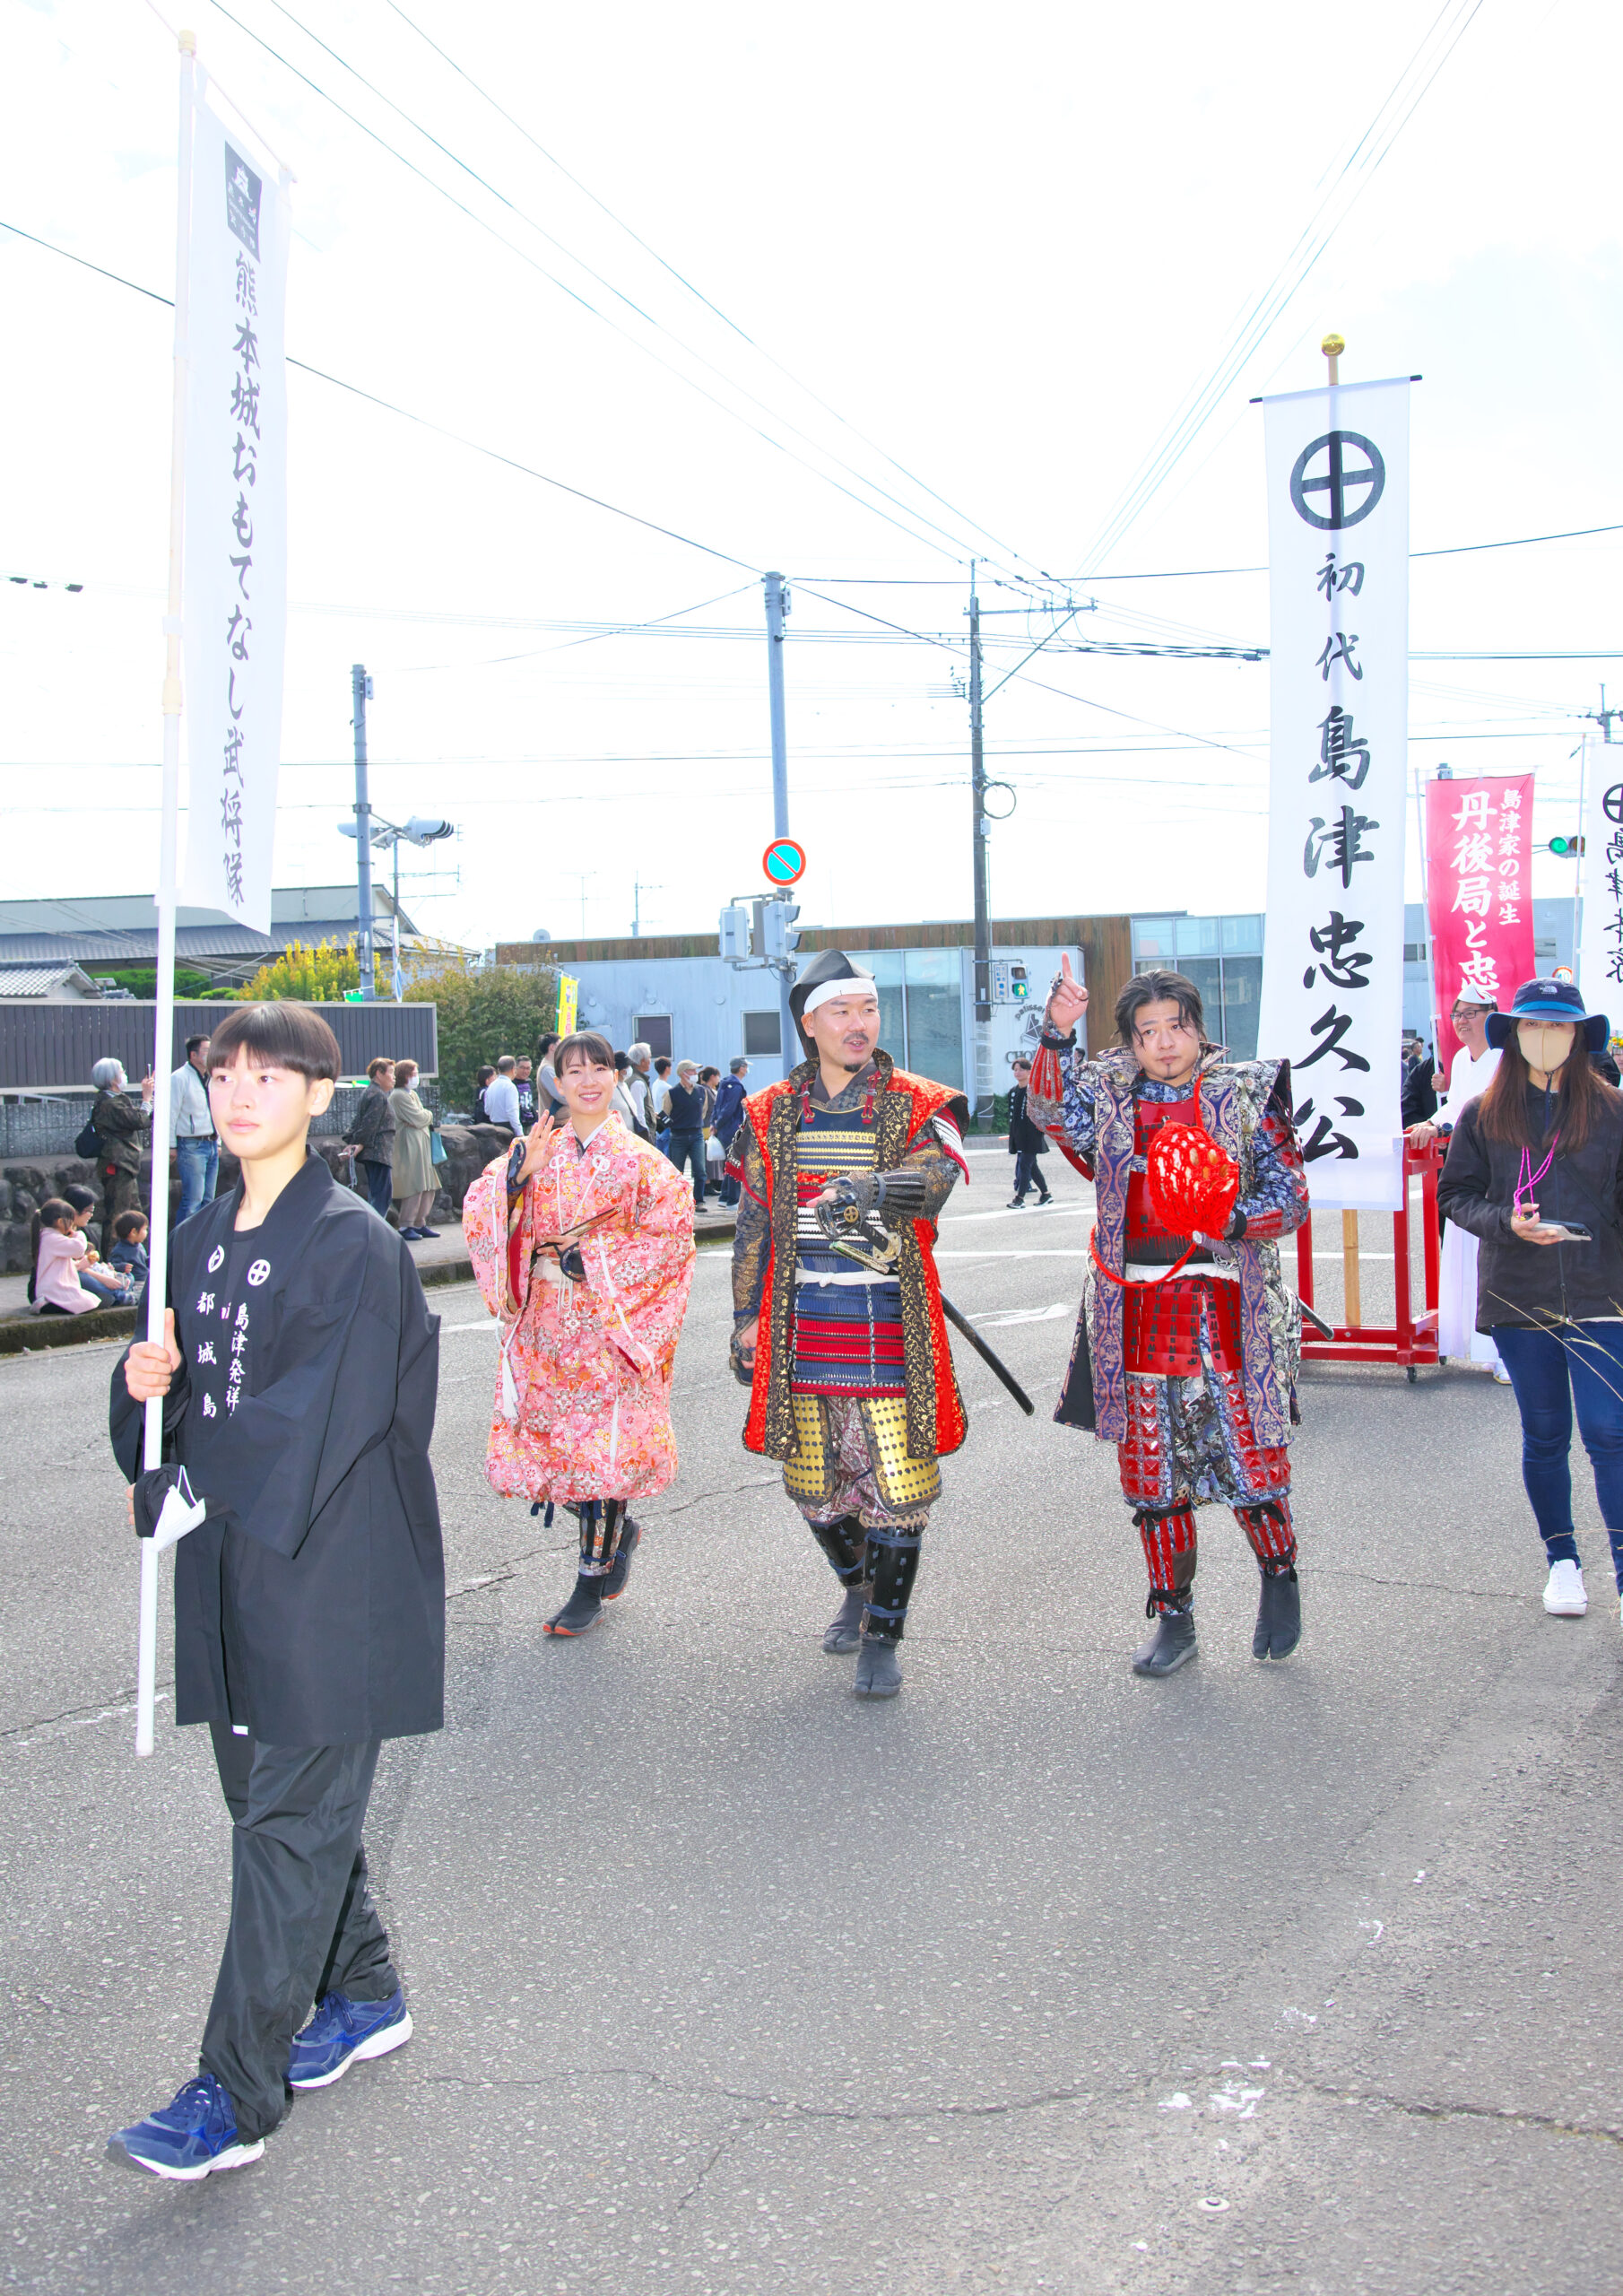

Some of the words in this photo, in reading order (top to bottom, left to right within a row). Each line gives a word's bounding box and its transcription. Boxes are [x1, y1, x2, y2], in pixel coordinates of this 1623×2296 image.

[221, 250, 261, 909] 熊本城おもてなし武将隊
[1291, 552, 1381, 1163] 初代島津忠久公
[1497, 788, 1523, 926] 島津家の誕生
[226, 1302, 248, 1417] 島津発祥
